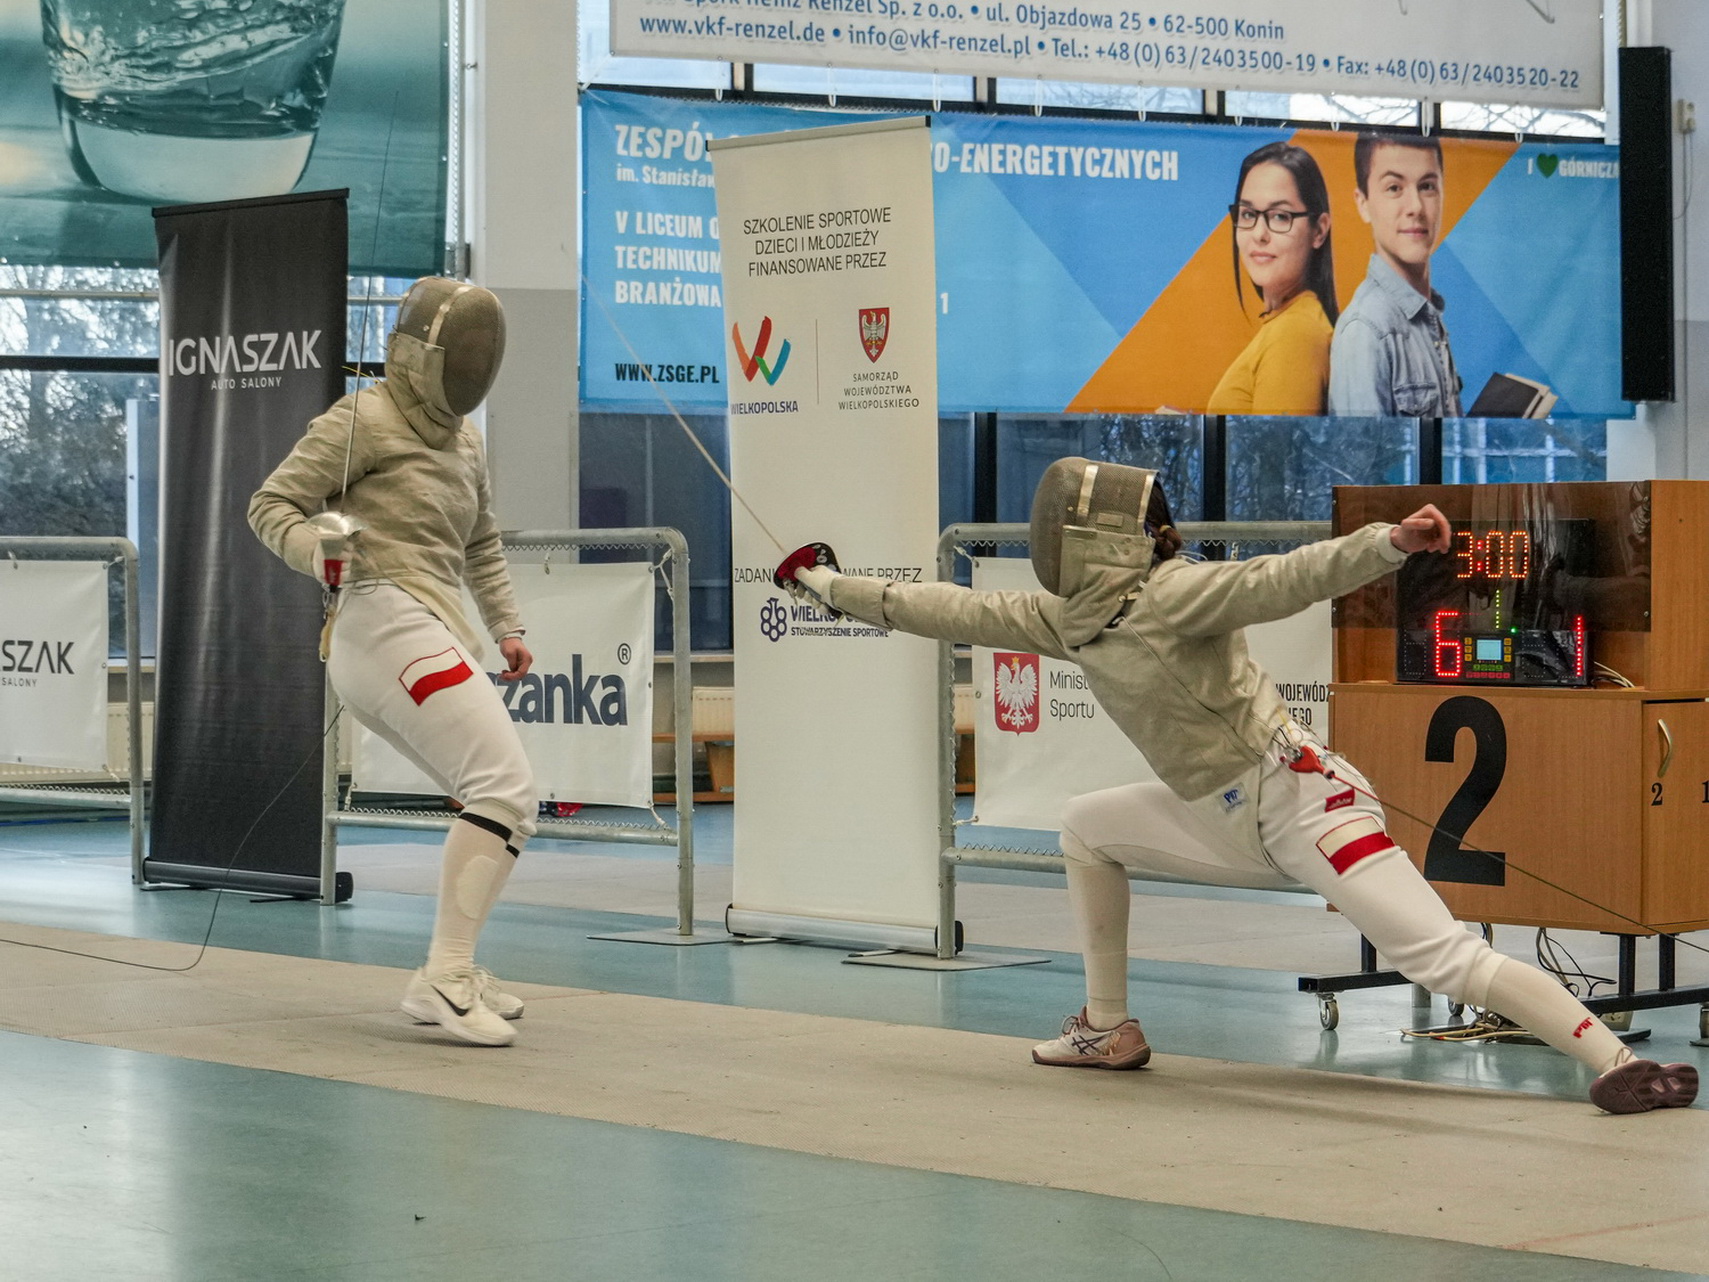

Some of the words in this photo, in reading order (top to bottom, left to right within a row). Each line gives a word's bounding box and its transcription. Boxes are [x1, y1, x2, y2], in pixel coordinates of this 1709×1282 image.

[809, 0, 872, 13] Renzel
[878, 0, 906, 18] Sp.
[913, 2, 922, 17] z
[928, 4, 963, 20] o.o.
[986, 3, 1009, 22] ul.
[1016, 5, 1113, 30] Objazdowa
[1119, 11, 1142, 31] 25
[1163, 14, 1229, 37] 62-500
[1234, 18, 1284, 40] Konin
[640, 15, 825, 42] www.vkf-renzel.de
[848, 25, 1031, 58] info@vkf-renzel.pl
[1051, 38, 1090, 58] Tel.:
[1336, 56, 1369, 75] Fax:
[616, 163, 639, 183] im.
[931, 142, 1179, 181] O-ENERGETYCZNYCH
[615, 210, 629, 234] V
[635, 211, 703, 239] LICEUM
[743, 214, 815, 235] SZKOLENIE
[818, 207, 892, 229] SPORTOWE
[755, 236, 798, 255] DZIECI
[808, 228, 879, 251] MŁODZIEŻY
[748, 255, 843, 277] FINANSOWANE
[845, 251, 887, 270] PRZEZ
[615, 277, 722, 308] BRANŻOWA
[169, 329, 322, 376] IGNASZAK
[211, 378, 236, 391] AUTO
[241, 376, 282, 389] SALONY
[614, 363, 720, 384] WWW.ZSGE.PL
[853, 371, 899, 383] SAMORZĄD
[838, 398, 920, 410] WIELKOPOLSKIEGO
[843, 384, 912, 397] WOJEWÓDZTWA
[731, 400, 799, 415] WIELKOPOLSKA
[1457, 531, 1528, 578] 3:00
[0, 640, 75, 675] SZAK
[1435, 611, 1461, 677] 6
[2, 677, 38, 688] SALONY
[1050, 698, 1095, 721] Sportu
[1424, 695, 1507, 887] 2
[1651, 782, 1663, 806] 2
